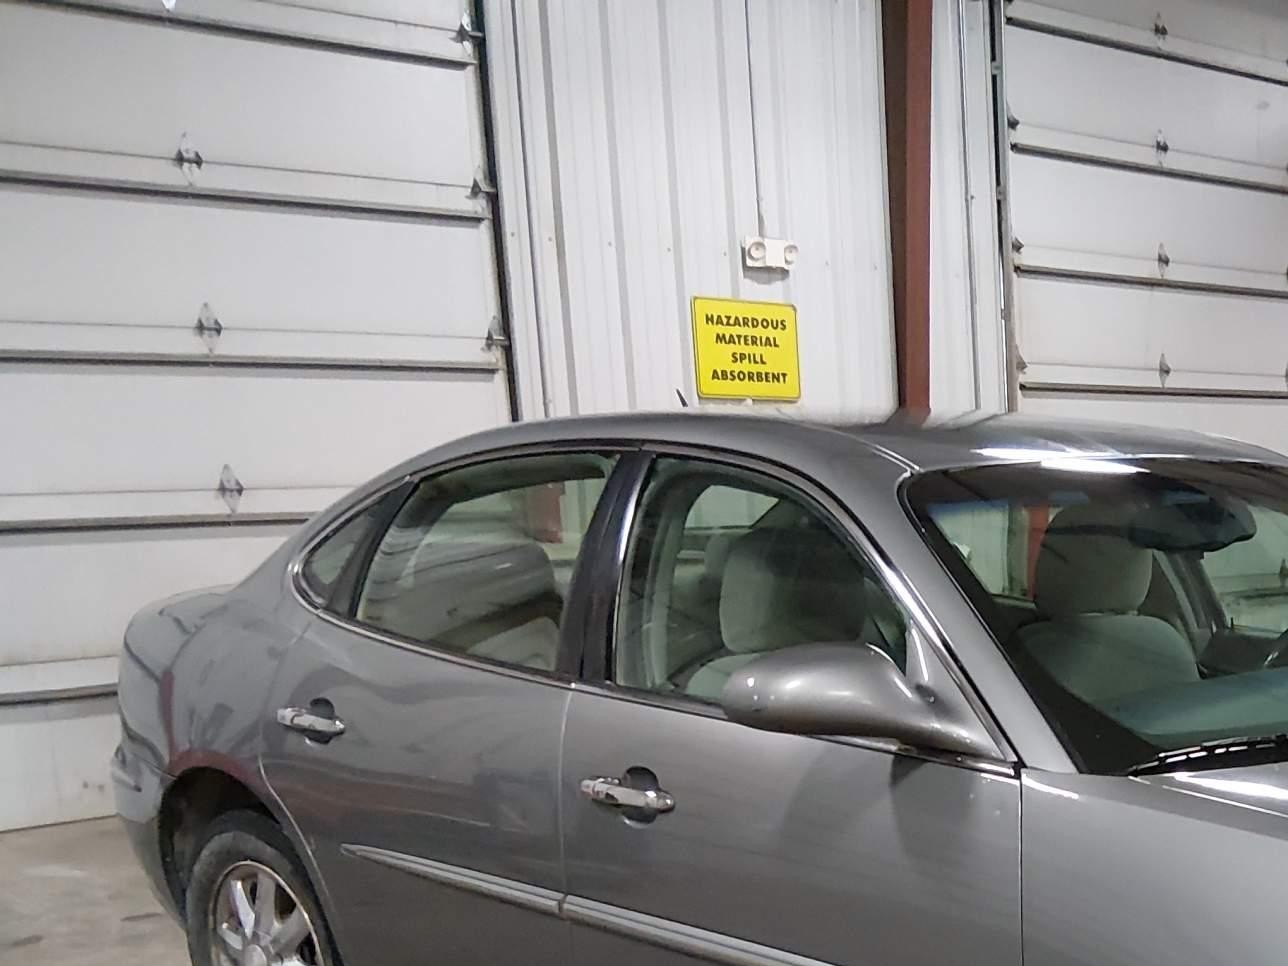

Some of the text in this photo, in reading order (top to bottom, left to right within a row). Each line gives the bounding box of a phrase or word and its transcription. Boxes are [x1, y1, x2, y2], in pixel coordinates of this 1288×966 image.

[705, 313, 787, 331] HAZARDOUS
[715, 333, 780, 348] MATERIAL
[731, 352, 767, 365] SPILL
[711, 369, 788, 384] ABSORBENT
